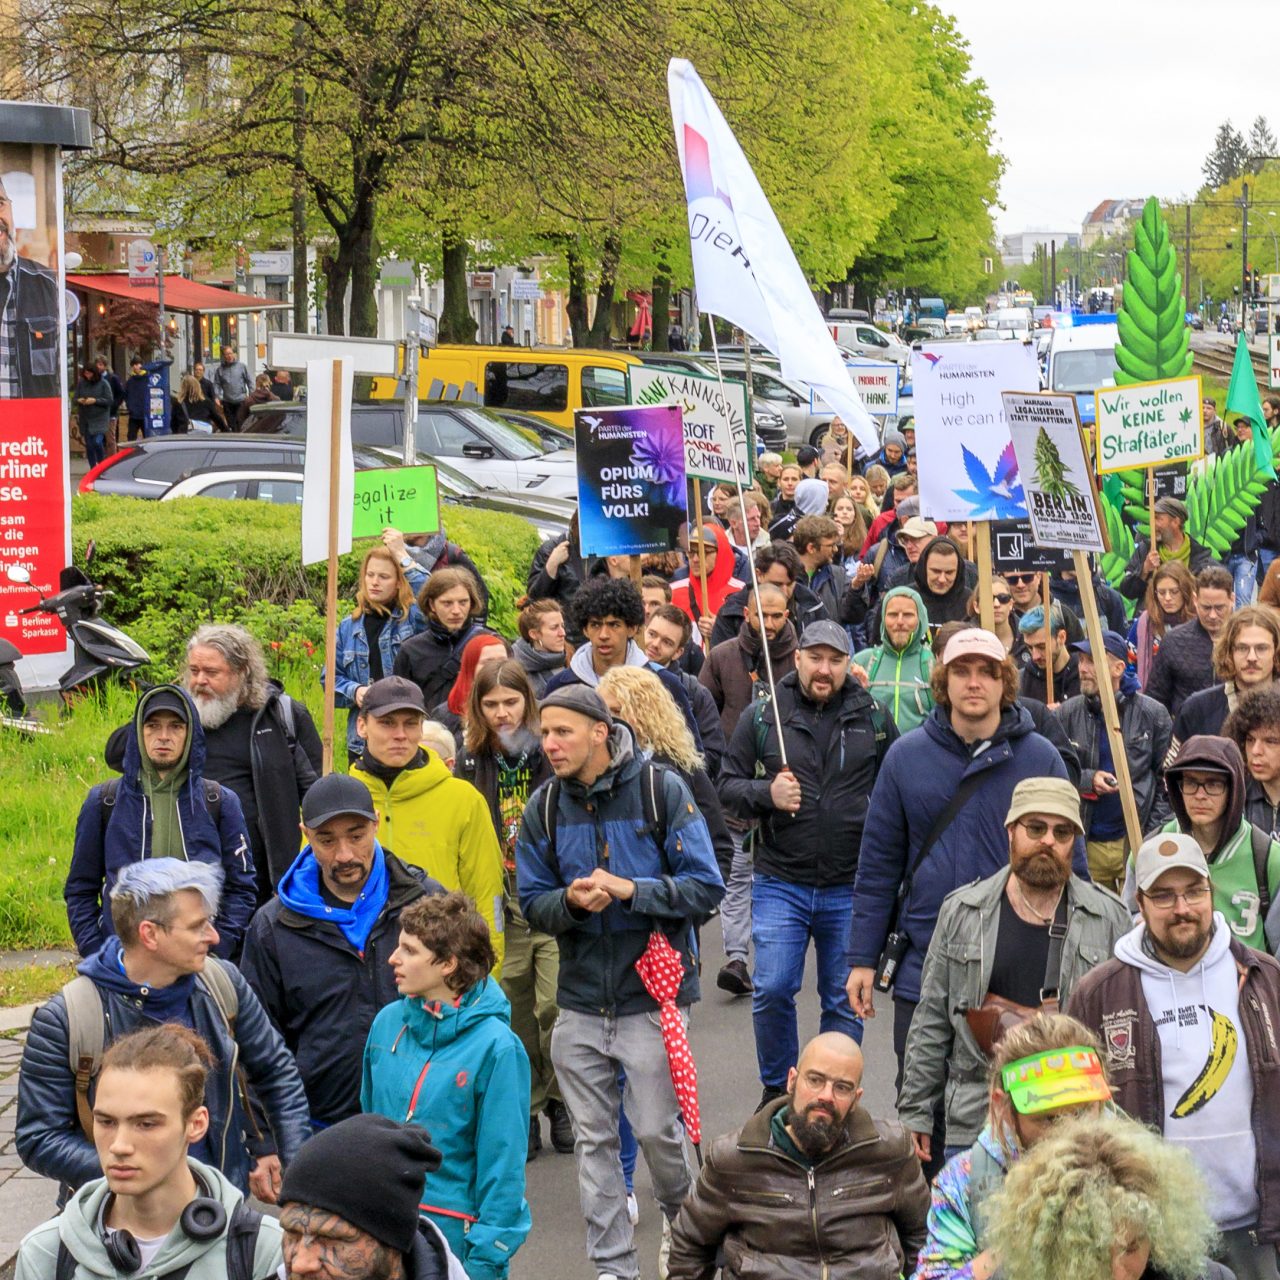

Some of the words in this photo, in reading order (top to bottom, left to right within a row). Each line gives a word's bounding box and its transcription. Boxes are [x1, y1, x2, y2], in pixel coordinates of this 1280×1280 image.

[939, 370, 995, 379] HUMANISTEN
[940, 391, 975, 409] High
[1102, 394, 1130, 415] Wir
[1140, 389, 1183, 407] wollen
[1014, 406, 1065, 416] LEGALISIEREN
[1122, 409, 1166, 429] KEINE
[942, 416, 964, 426] we
[967, 414, 995, 425] can
[1010, 414, 1030, 422] STATT
[1031, 415, 1074, 425] INHAFTIEREN
[598, 430, 647, 440] HUMANISTEN
[1103, 429, 1178, 460] Straftäter
[1164, 433, 1197, 459] sein!
[600, 465, 653, 481] OPIUM
[702, 455, 746, 476] MEDIZN
[353, 483, 417, 511] egalize
[601, 485, 643, 501] FÜRS
[1033, 491, 1089, 513] BERLIN
[380, 506, 394, 524] it
[602, 504, 649, 519] VOLK!
[22, 616, 52, 627] Berliner
[22, 628, 59, 639] Sparkasse
[1162, 1008, 1174, 1017] THE
[1174, 1005, 1195, 1013] ELVET
